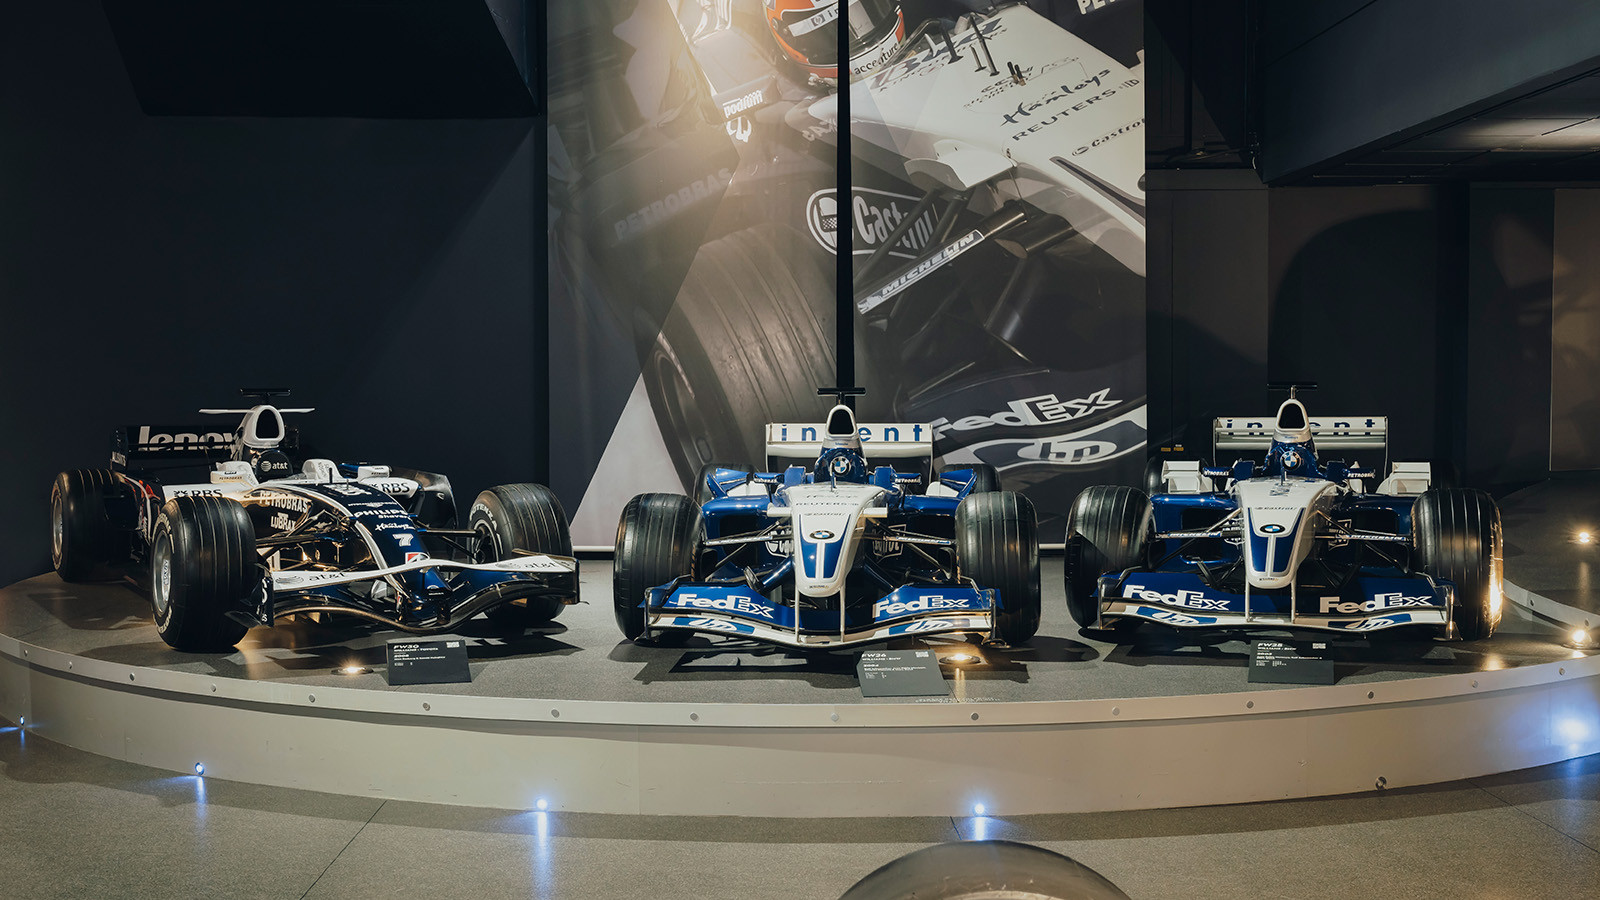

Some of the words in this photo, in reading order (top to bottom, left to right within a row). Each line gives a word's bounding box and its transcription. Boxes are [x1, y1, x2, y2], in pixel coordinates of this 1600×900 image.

[1000, 69, 1111, 127] Hamleys
[1012, 89, 1097, 141] REUTERS
[614, 168, 733, 241] PETROBRAS
[882, 233, 975, 296] MICHELIN
[933, 387, 1123, 441] FedEx
[1226, 418, 1376, 436] inent
[138, 425, 234, 451] lenov
[781, 424, 922, 442] inent
[191, 488, 223, 498] RBS
[381, 482, 410, 494] RBS
[393, 533, 414, 547] 7
[677, 593, 775, 619] FedEx
[872, 595, 970, 619] FedEx
[1122, 584, 1231, 611] FedEx
[1319, 592, 1434, 614] FedEx
